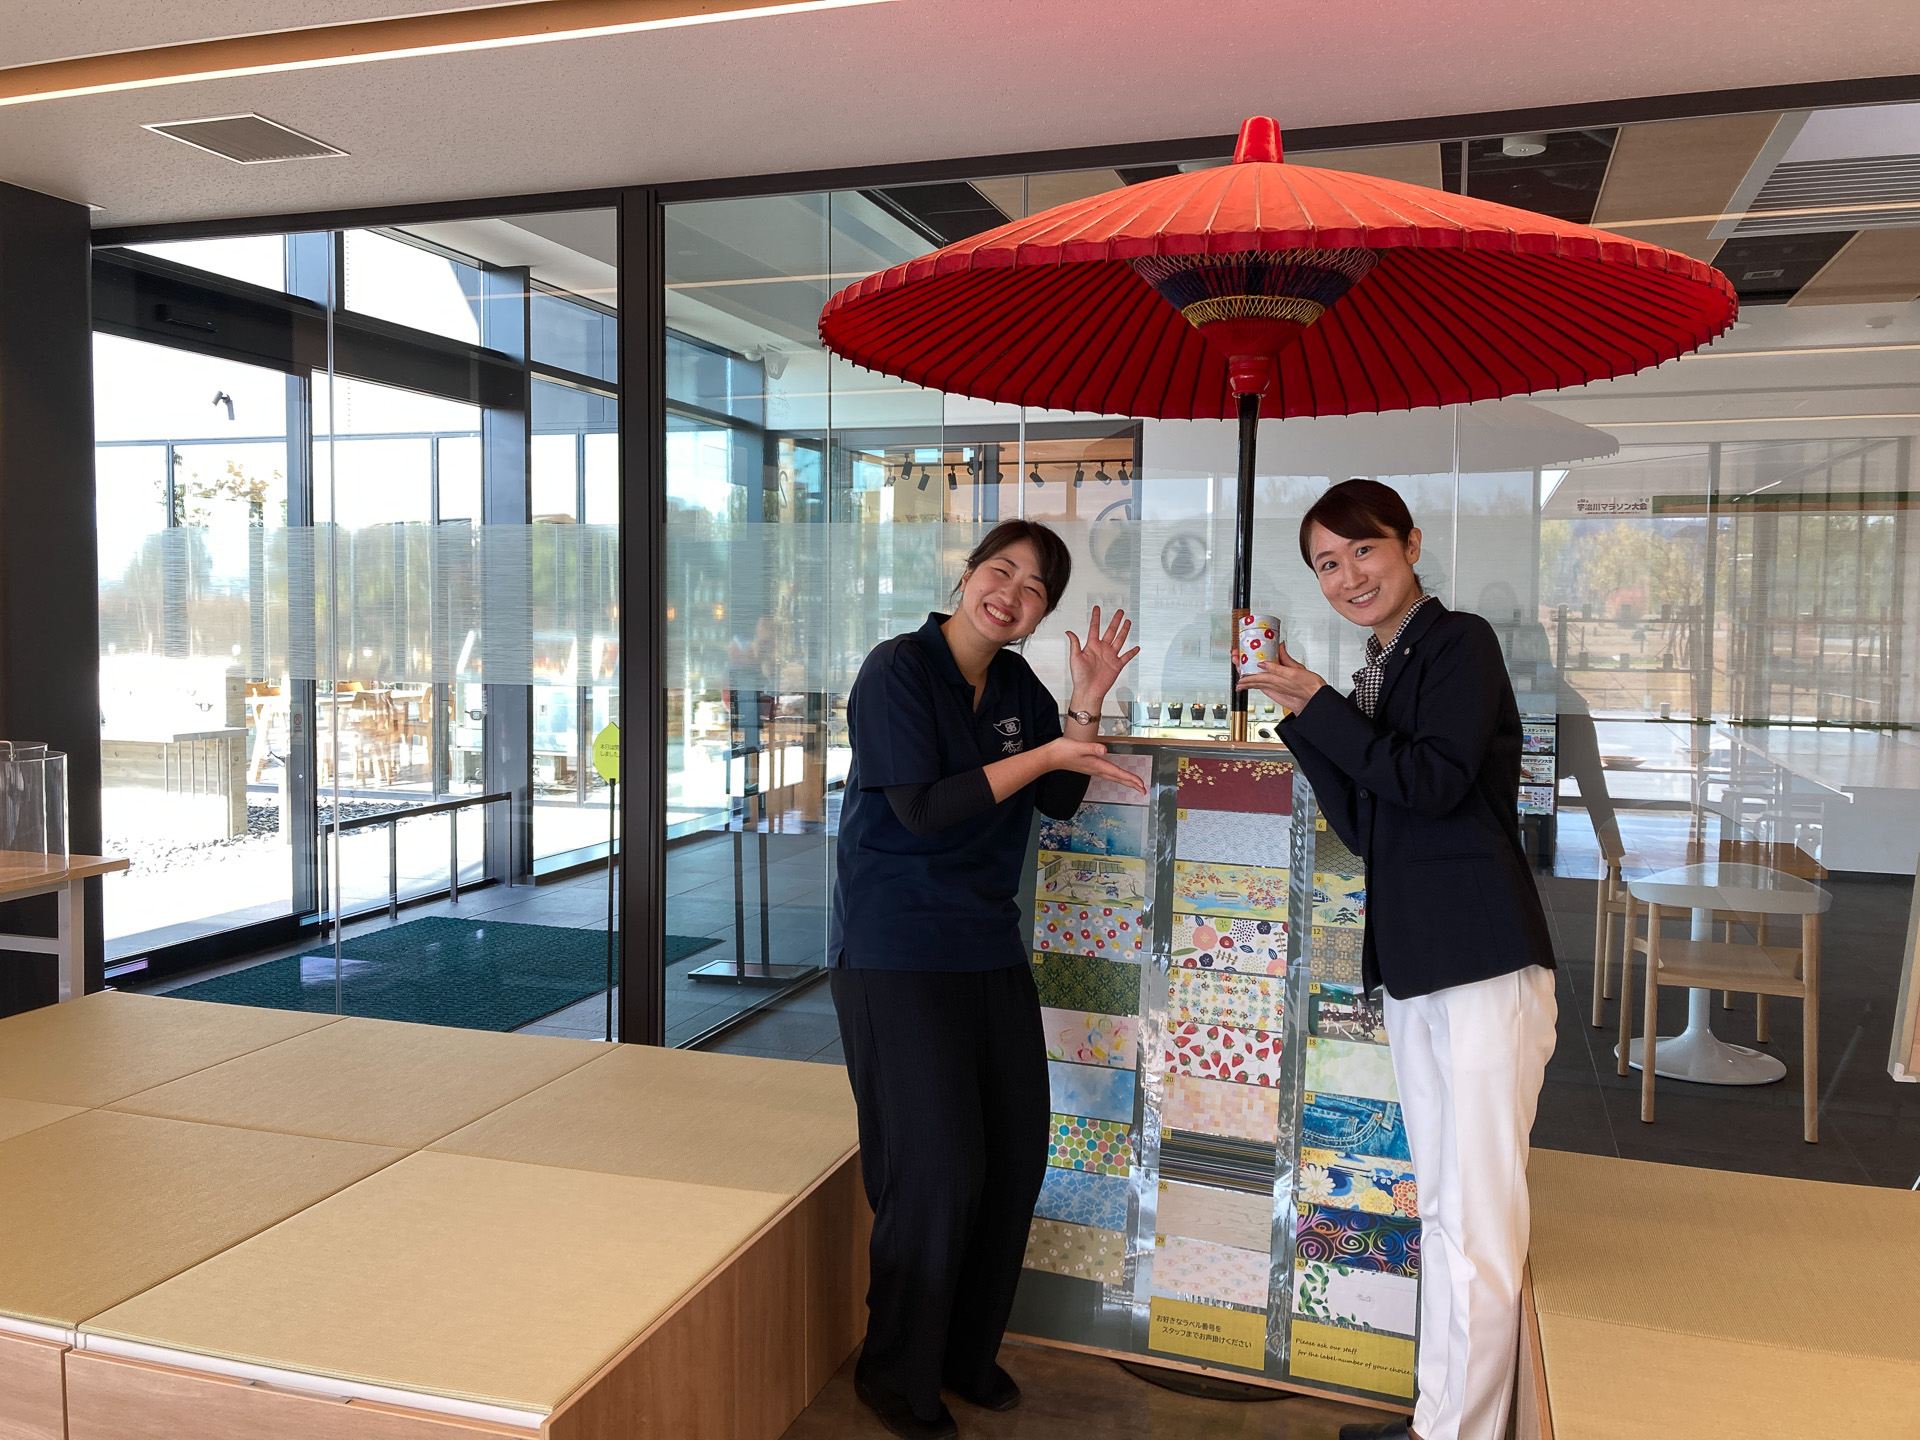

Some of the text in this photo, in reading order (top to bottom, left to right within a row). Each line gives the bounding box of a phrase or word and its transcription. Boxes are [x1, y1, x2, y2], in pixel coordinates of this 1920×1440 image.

[1577, 502, 1648, 512] 宇治川マラソン大会
[1156, 1315, 1222, 1333] お好きなラベル番号を
[1162, 1326, 1252, 1348] スタッフまでお声掛けください
[1295, 1338, 1316, 1347] Please
[1342, 1347, 1358, 1355] staff
[1320, 1353, 1337, 1361] label
[1338, 1357, 1364, 1366] number
[1365, 1361, 1372, 1369] of
[1389, 1367, 1413, 1376] choice.
